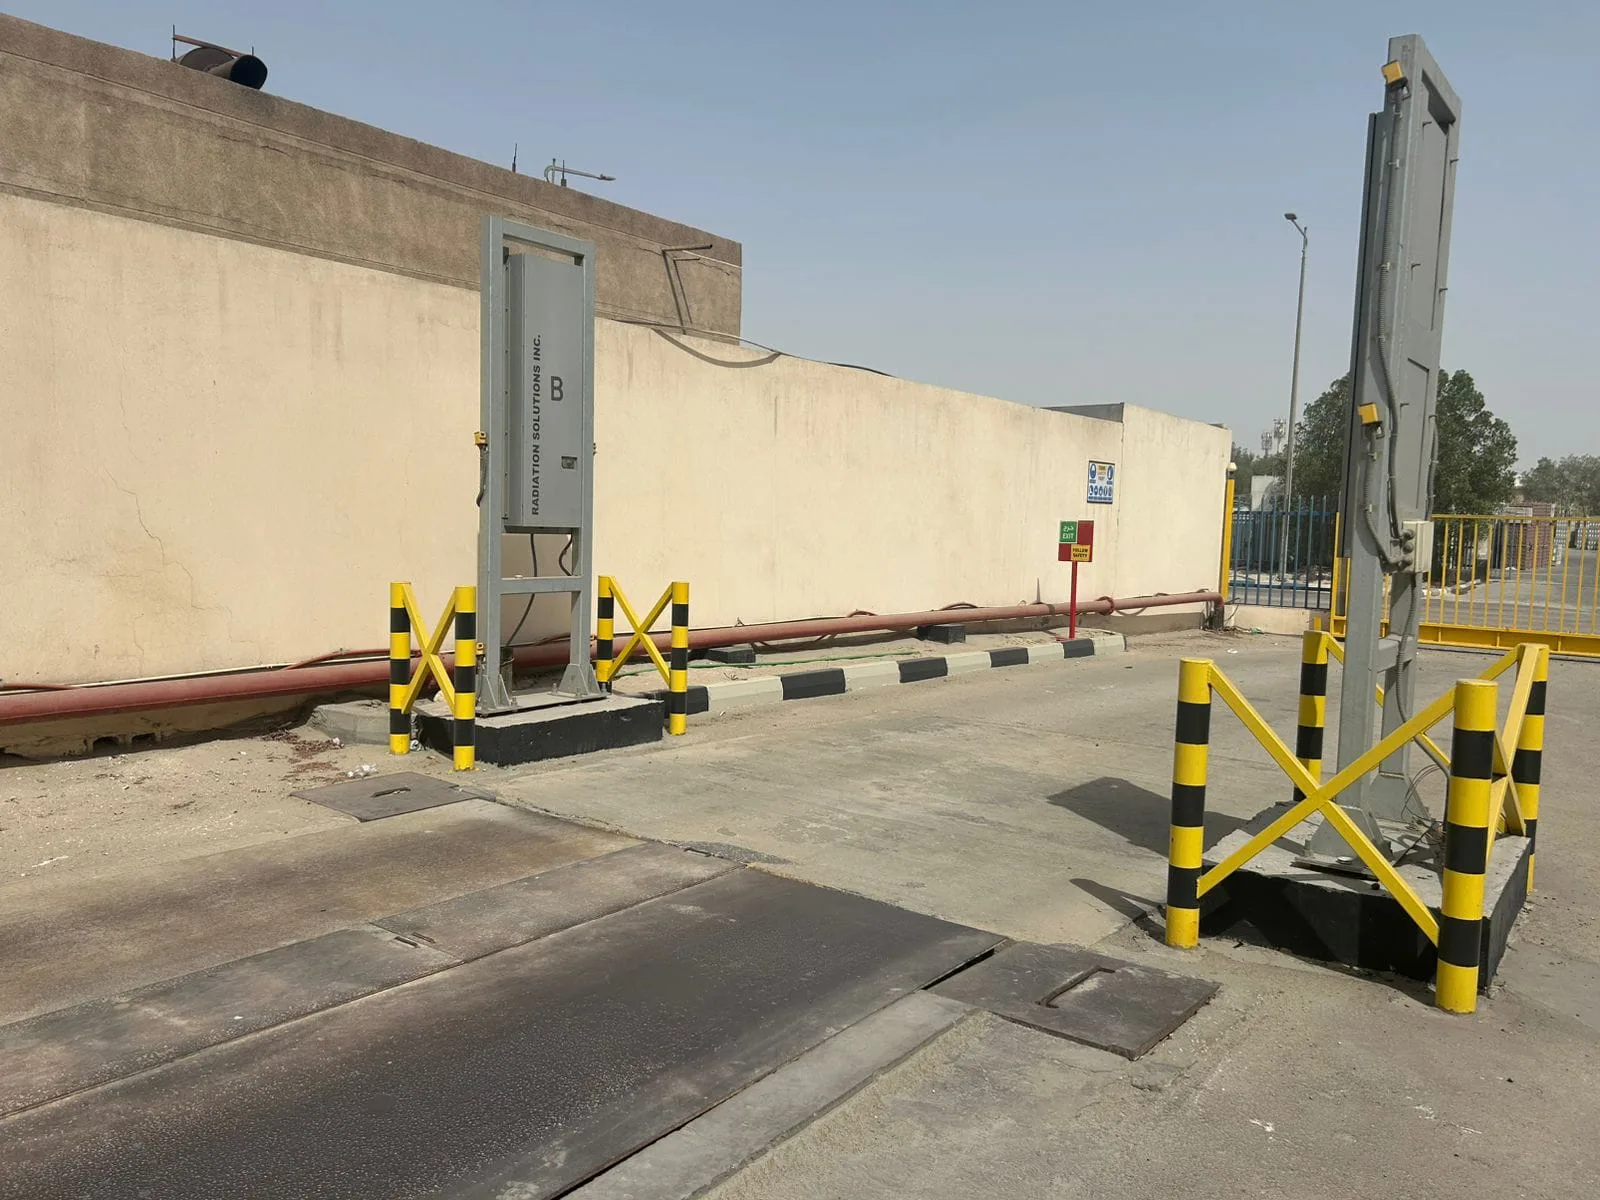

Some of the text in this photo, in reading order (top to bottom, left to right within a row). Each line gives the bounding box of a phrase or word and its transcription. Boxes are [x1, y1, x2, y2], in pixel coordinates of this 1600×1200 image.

[532, 334, 541, 516] RADIATION SOLUTIONS INC.
[551, 375, 564, 401] B
